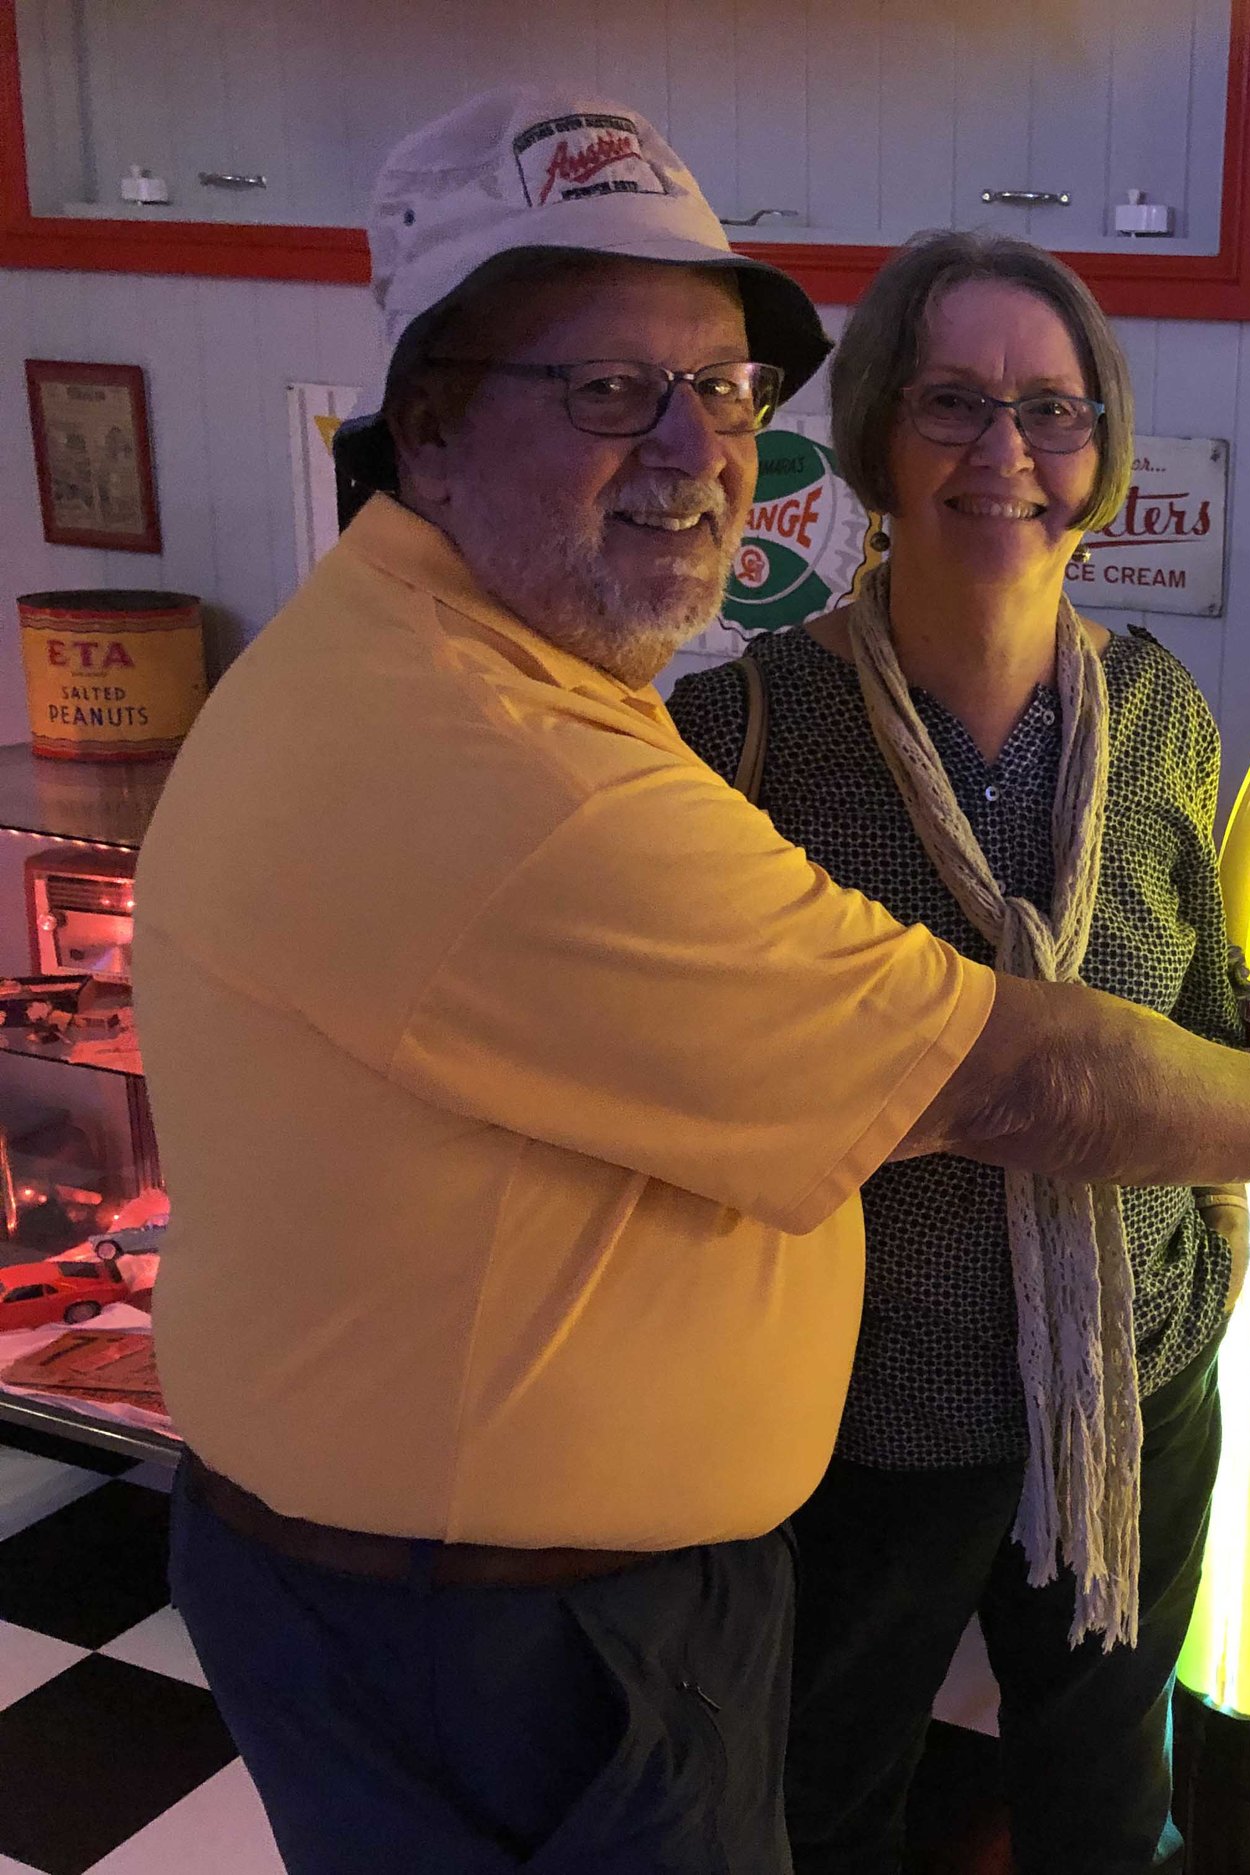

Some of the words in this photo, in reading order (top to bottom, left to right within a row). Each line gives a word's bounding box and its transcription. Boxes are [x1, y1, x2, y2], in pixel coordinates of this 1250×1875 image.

[539, 130, 640, 206] Austin
[1131, 457, 1166, 472] or...
[745, 486, 823, 549] ANGE
[1103, 485, 1211, 538] ters
[1065, 563, 1095, 582] CE
[1103, 565, 1186, 588] CREAM
[47, 640, 136, 668] ETA
[62, 686, 126, 701] SALTED
[48, 704, 149, 727] PEANUTS
